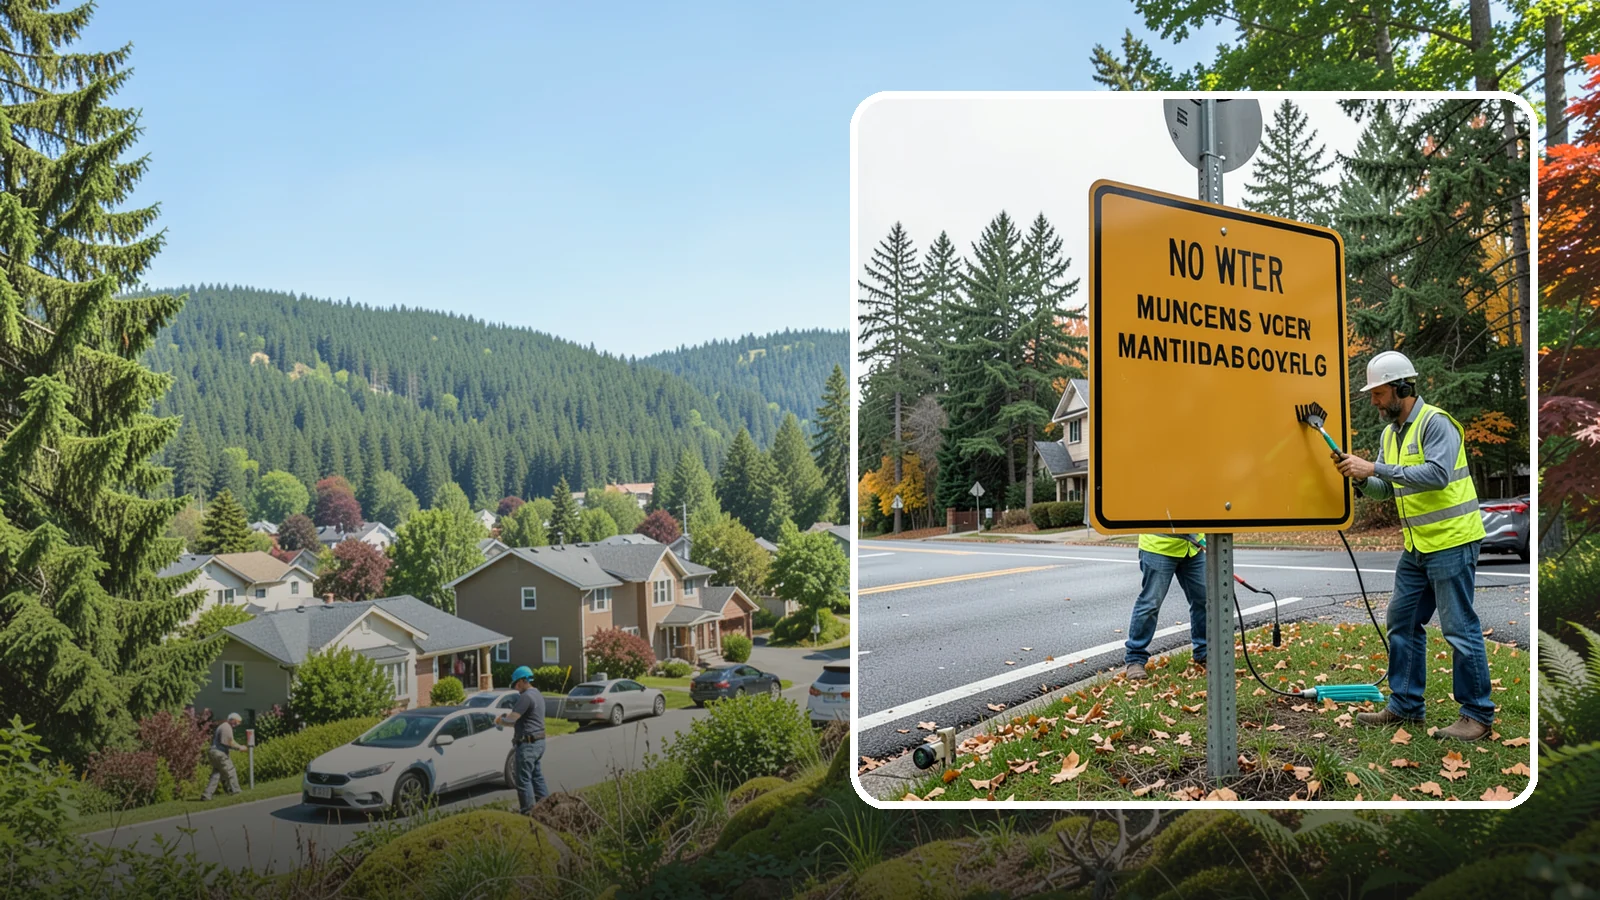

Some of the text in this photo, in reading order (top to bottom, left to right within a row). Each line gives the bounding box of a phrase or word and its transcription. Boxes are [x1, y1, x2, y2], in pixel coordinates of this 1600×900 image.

[1169, 237, 1284, 295] NO WTER
[1137, 293, 1252, 333] MUNCENS
